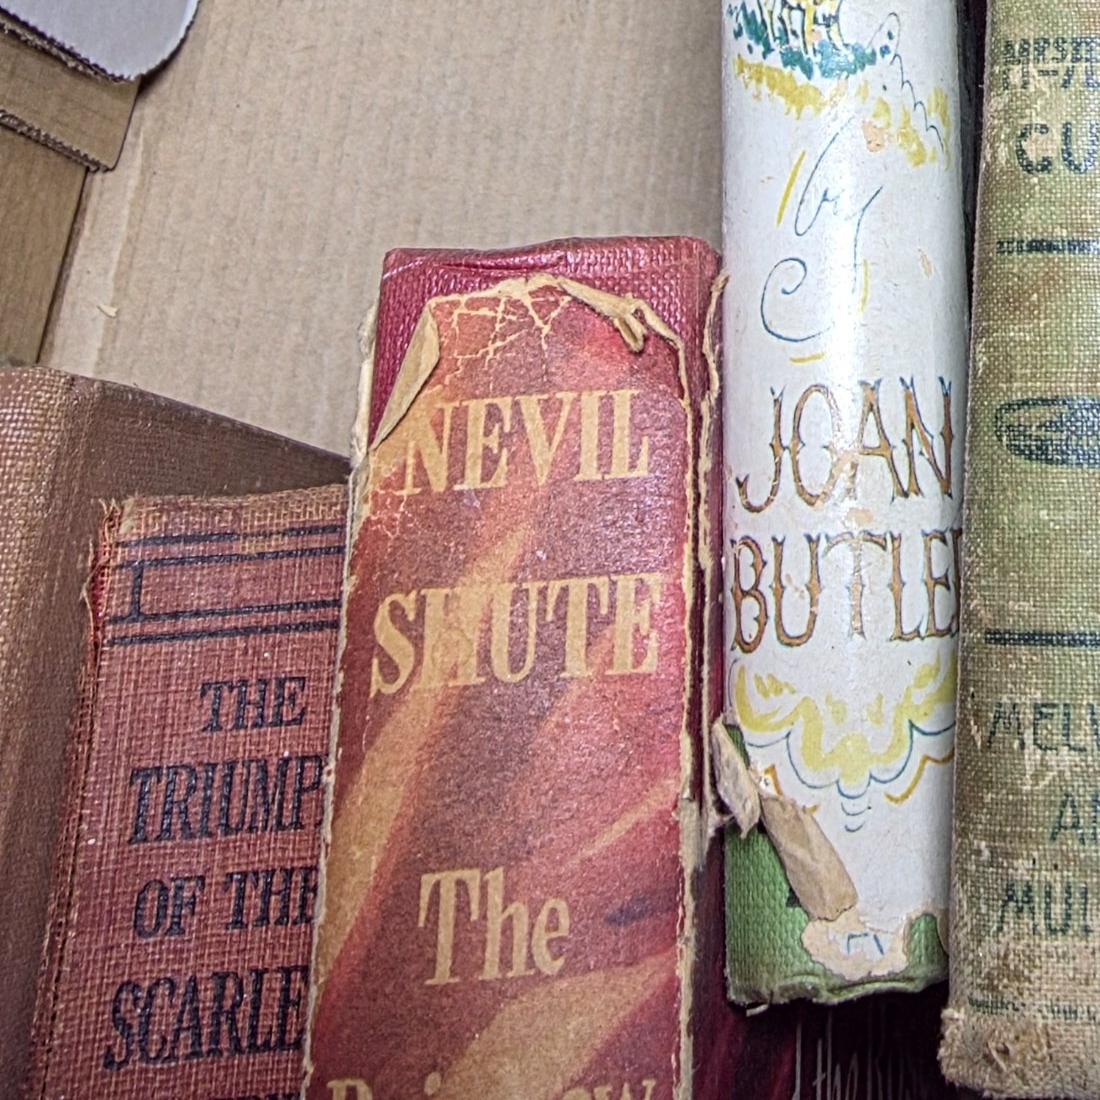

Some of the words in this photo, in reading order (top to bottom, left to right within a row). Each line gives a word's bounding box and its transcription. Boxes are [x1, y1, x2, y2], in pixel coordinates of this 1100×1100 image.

[395, 389, 650, 497] NEVIL
[736, 377, 955, 514] JOAN
[368, 572, 664, 699] SHUTE
[200, 676, 307, 732] THE
[127, 754, 327, 845] TRIUMP
[133, 874, 205, 938] OF
[418, 866, 572, 986] The
[103, 965, 310, 1073] SCARLE
